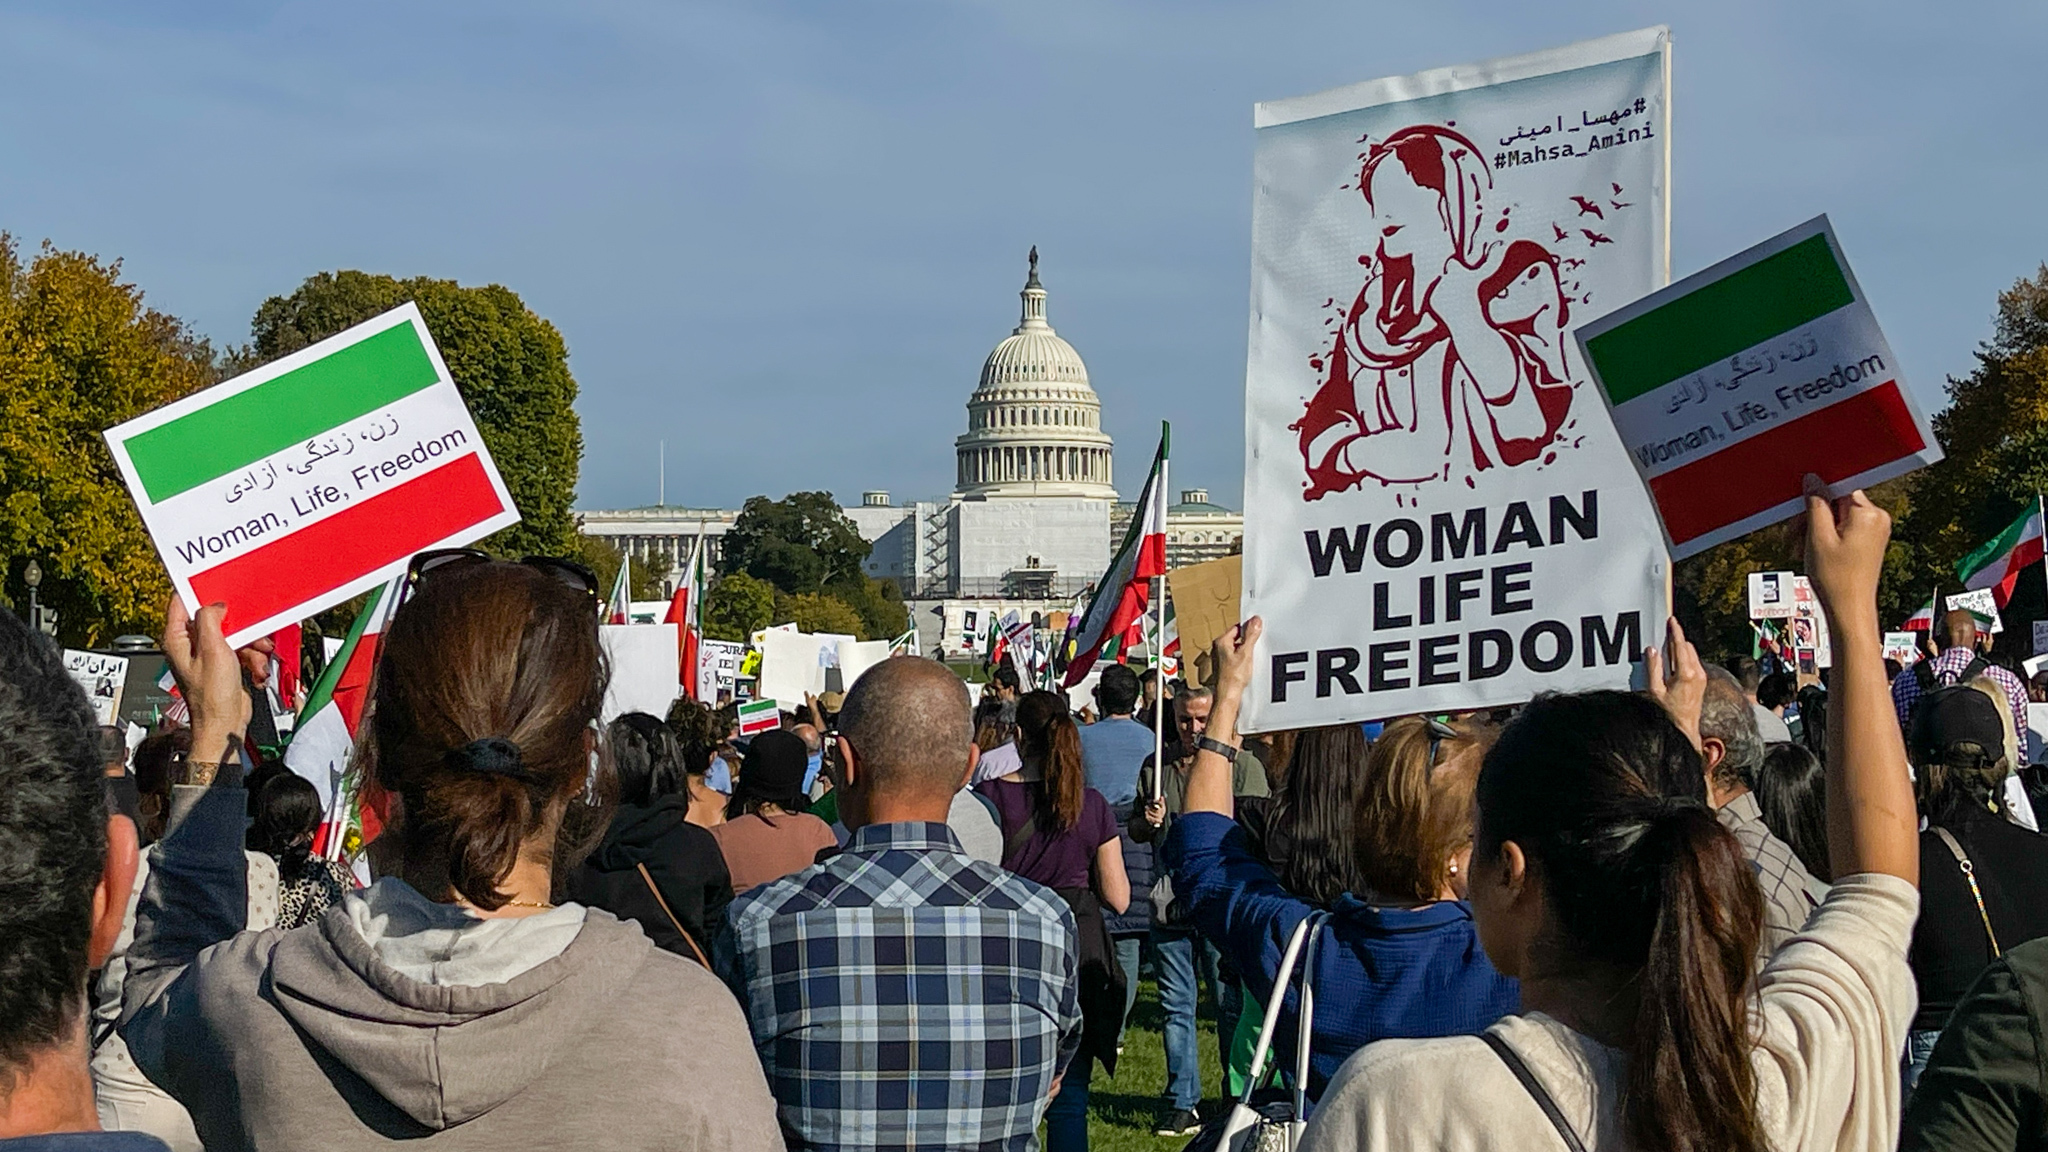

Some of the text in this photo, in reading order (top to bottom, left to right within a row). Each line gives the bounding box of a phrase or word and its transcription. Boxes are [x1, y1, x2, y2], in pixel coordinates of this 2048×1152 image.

[1494, 121, 1655, 170] #Mahsa_Amini
[1499, 98, 1647, 147] #مهسا_امینی
[1636, 355, 1885, 468] Woman, Life, Freedom
[175, 428, 467, 565] Woman, Life, Freedom
[225, 459, 279, 503] آزادی
[1304, 489, 1599, 578] WOMAN
[1373, 561, 1533, 632] LIFE
[1270, 610, 1642, 703] FREEDOM
